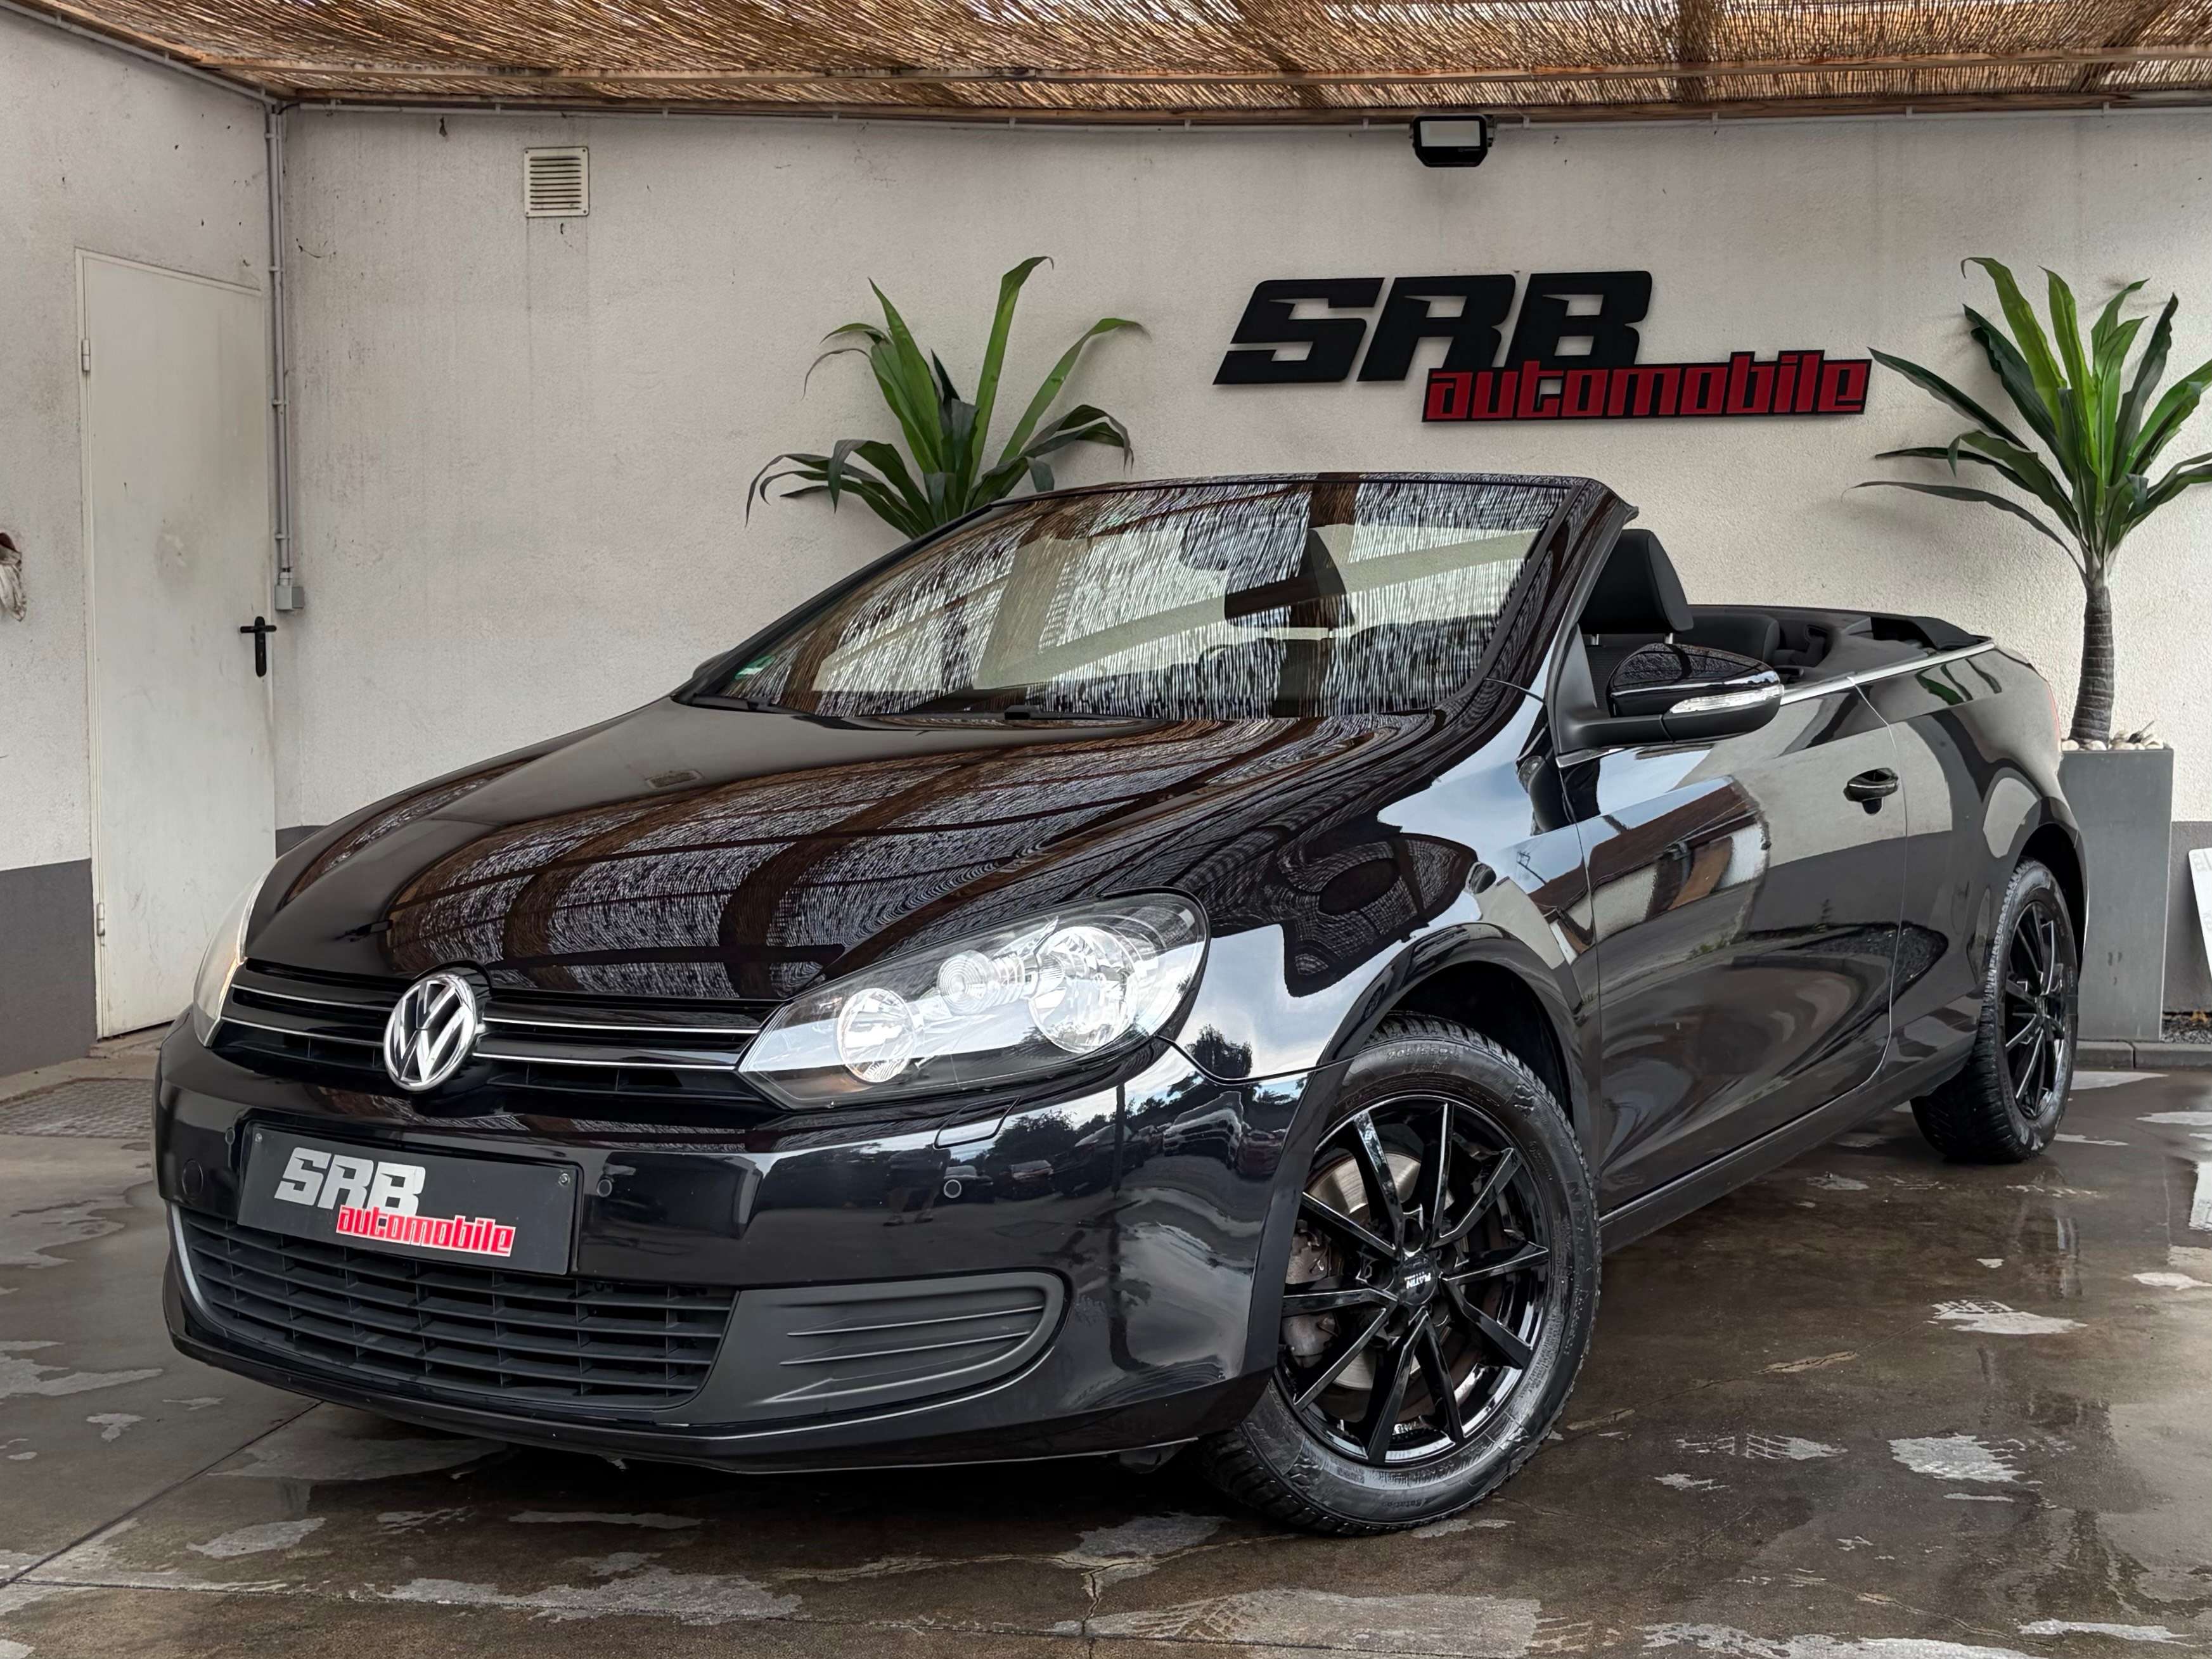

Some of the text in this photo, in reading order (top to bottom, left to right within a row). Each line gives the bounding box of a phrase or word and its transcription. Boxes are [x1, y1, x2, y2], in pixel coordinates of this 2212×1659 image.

[1212, 271, 1652, 385] SRB
[1424, 350, 1871, 421] automobile
[386, 975, 474, 1087] VW
[274, 1147, 425, 1216] SRB
[336, 1205, 515, 1257] automobile
